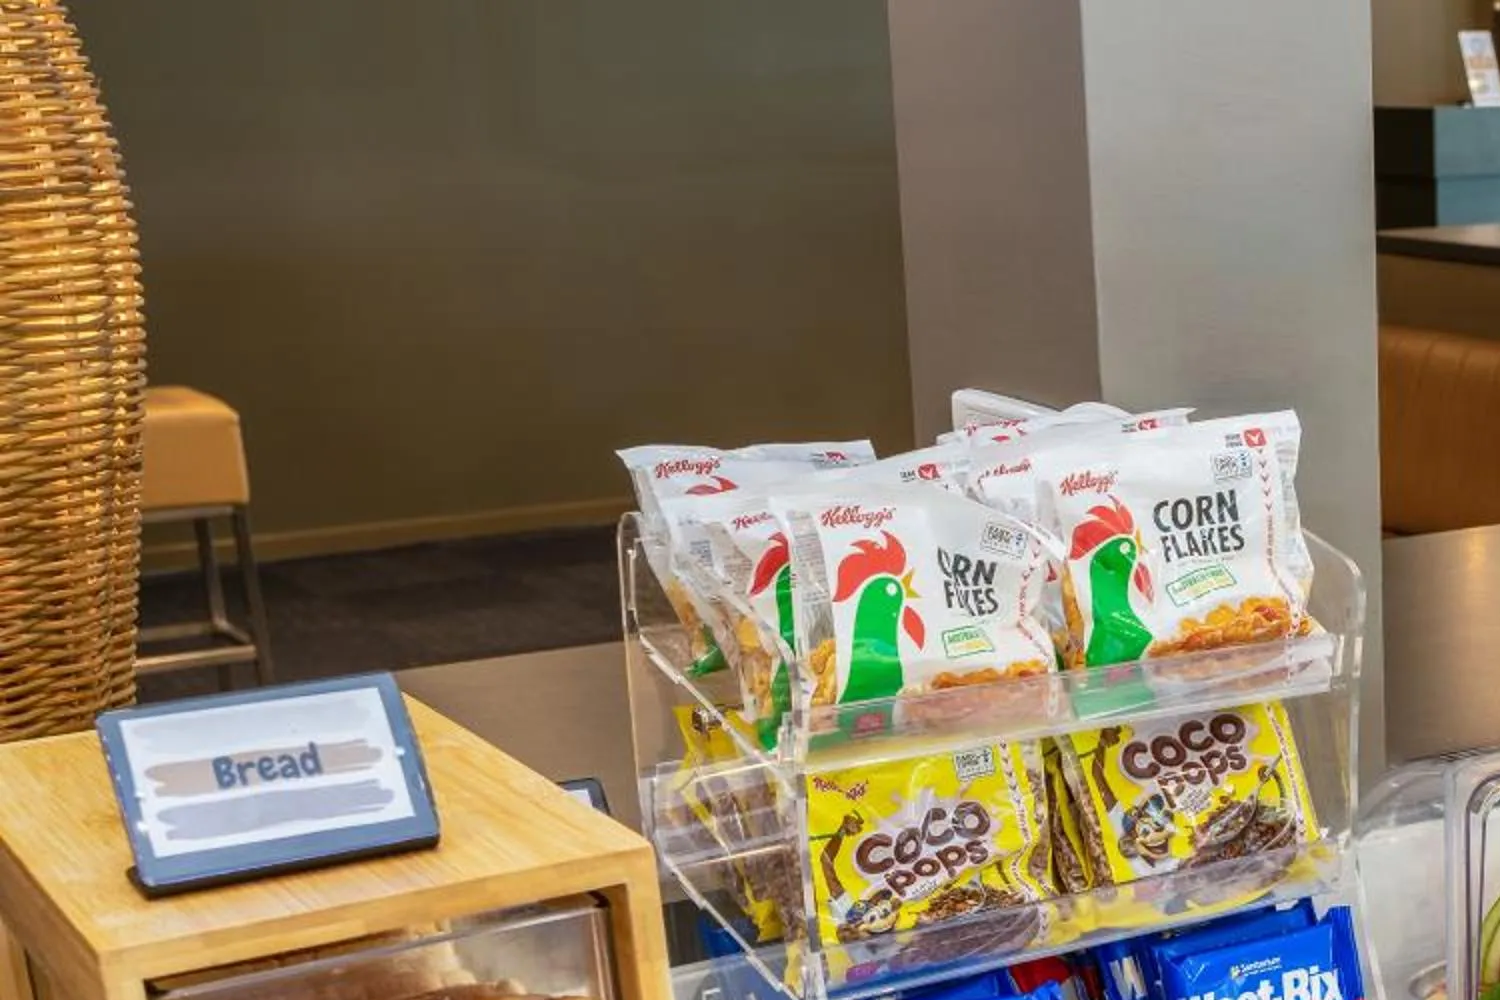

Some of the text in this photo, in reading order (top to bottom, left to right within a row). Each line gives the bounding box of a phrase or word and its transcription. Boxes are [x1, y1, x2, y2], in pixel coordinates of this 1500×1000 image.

[1060, 471, 1118, 496] Kellogg's
[821, 506, 897, 529] Kellogg's
[1153, 489, 1239, 533] CORN
[1160, 524, 1245, 563] FLAKES
[211, 742, 323, 790] Bread
[1122, 713, 1246, 779] COCO
[856, 801, 991, 875] COCO
